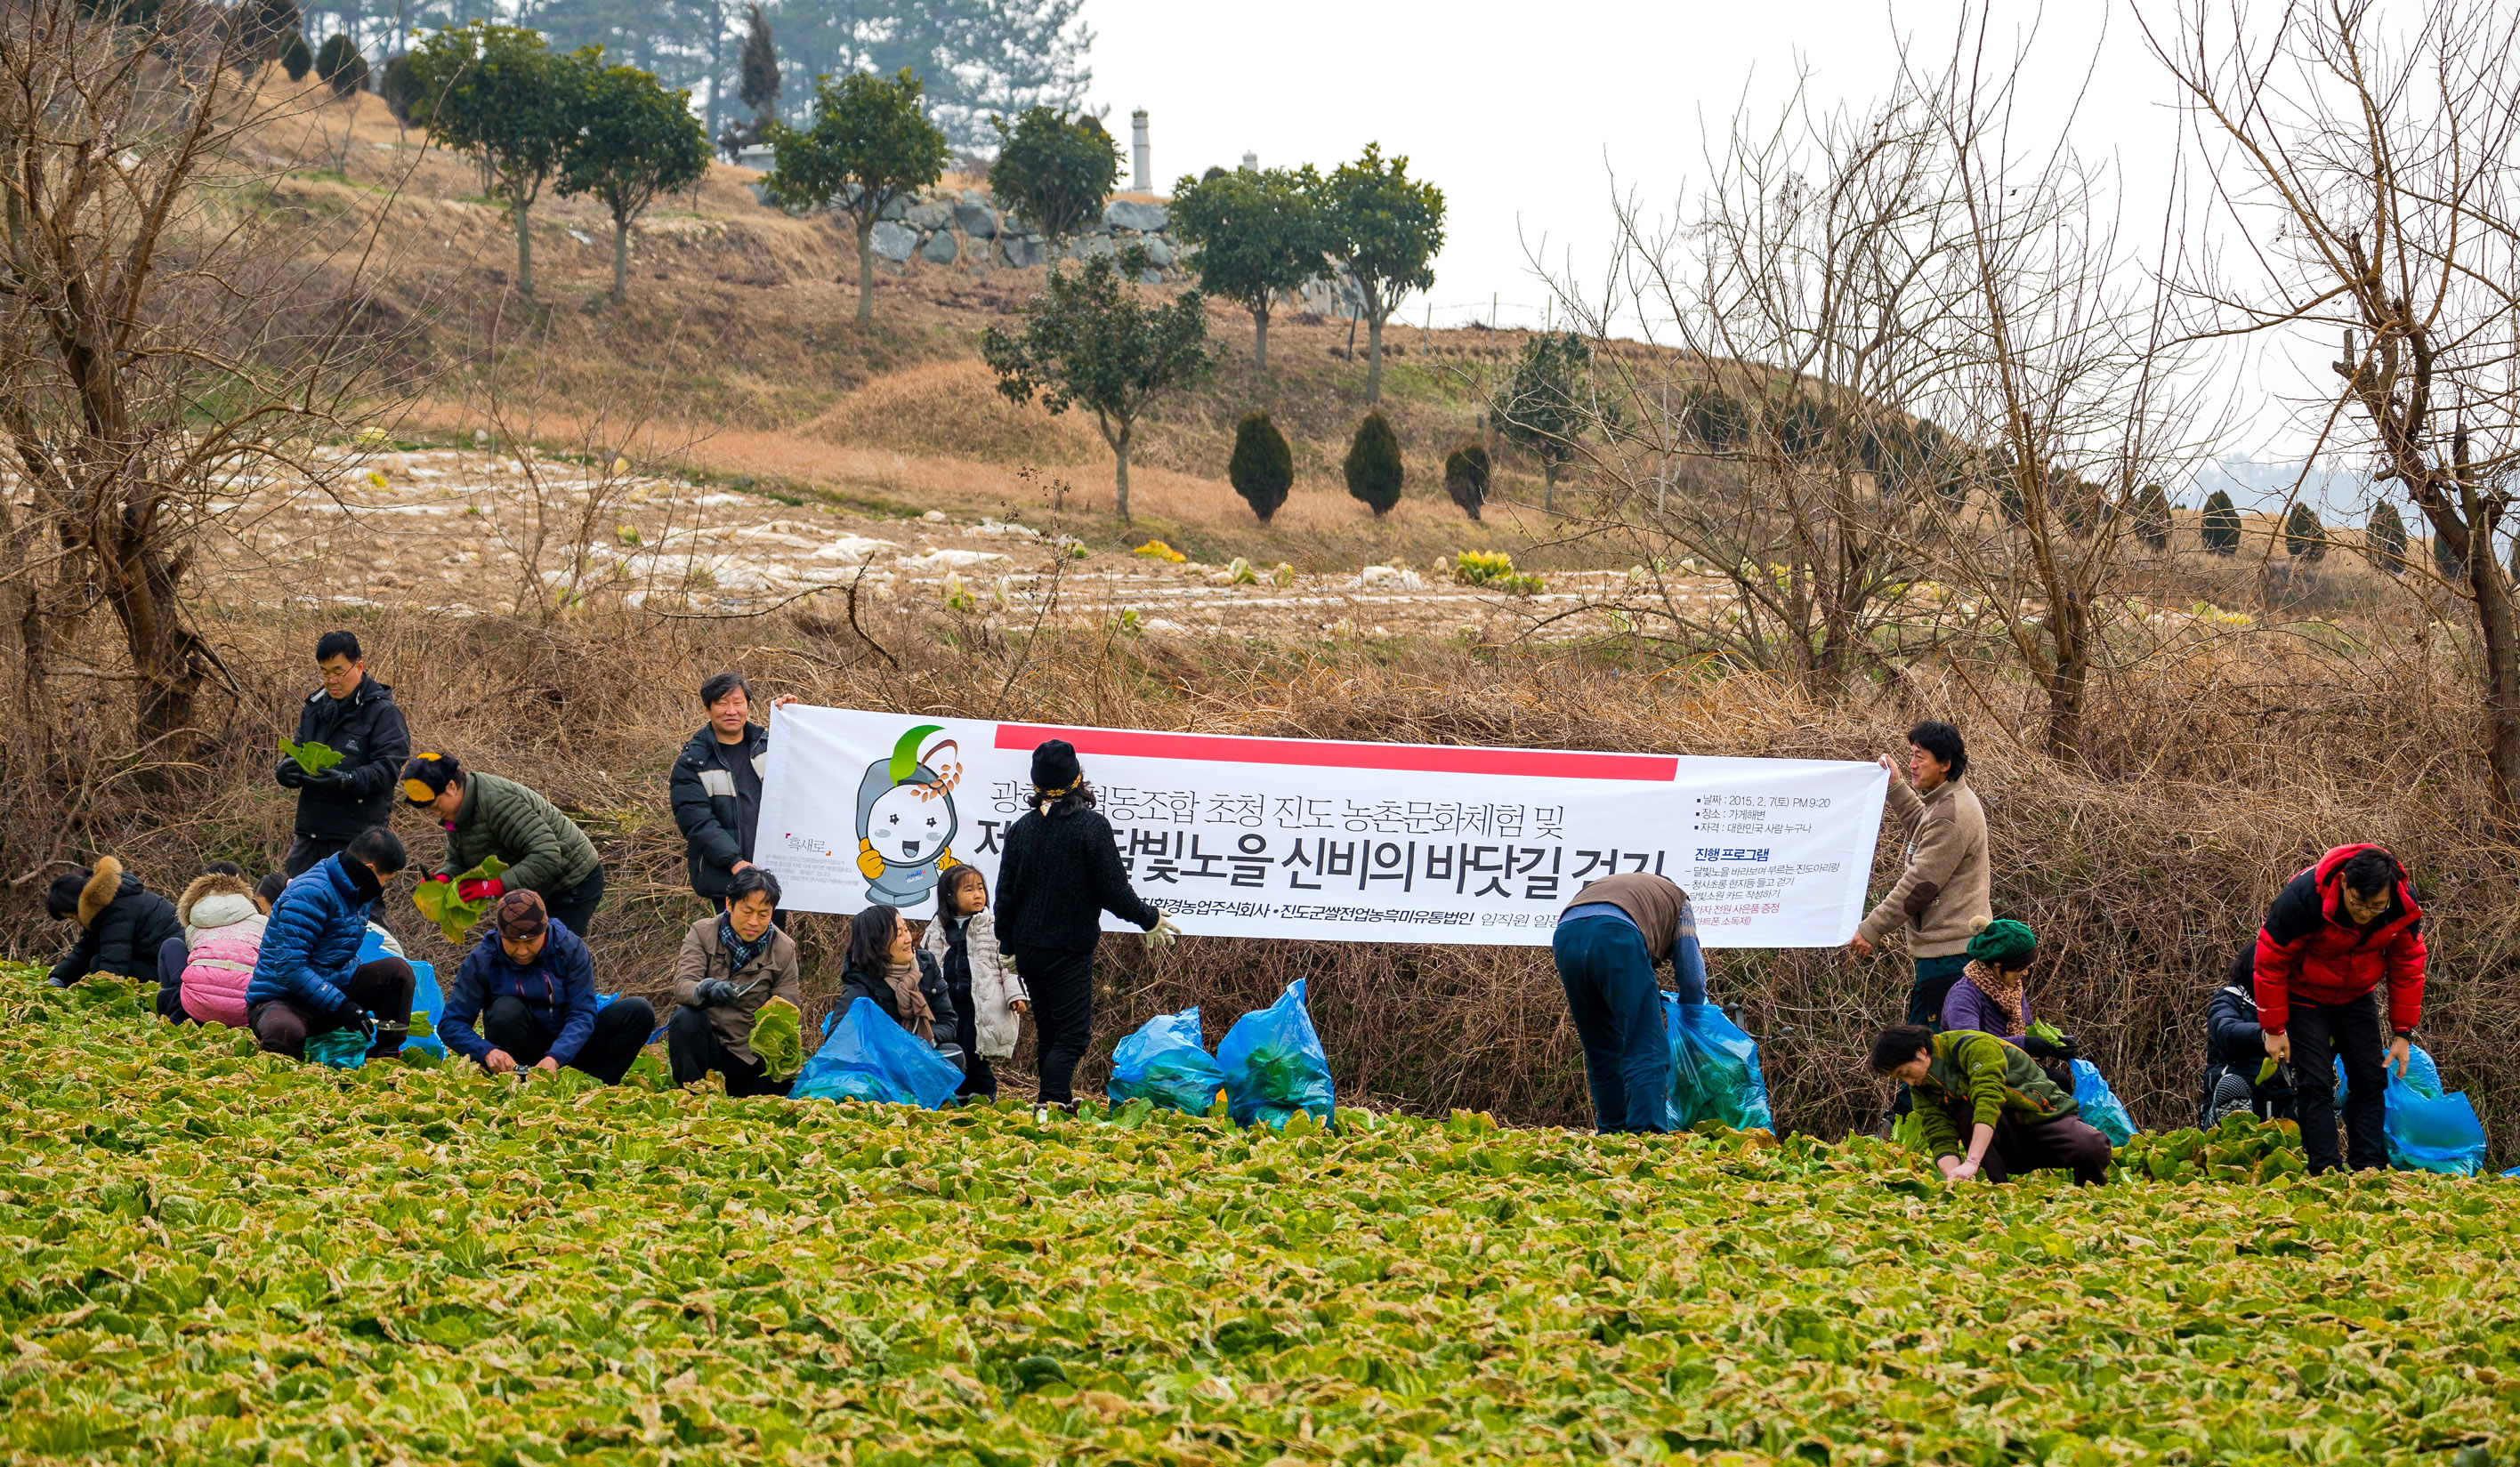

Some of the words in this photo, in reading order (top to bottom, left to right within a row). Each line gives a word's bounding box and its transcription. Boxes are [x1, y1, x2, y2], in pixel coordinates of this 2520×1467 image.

[1702, 794, 1722, 806] 날짜
[1204, 793, 1264, 827] 초청
[1272, 794, 1335, 829] 진도
[1341, 798, 1525, 838] 농촌문화체험
[1534, 804, 1563, 840] 및
[1701, 808, 1721, 819] 장소
[1728, 809, 1766, 821] 가게해변
[1700, 822, 1719, 834] 자격
[1727, 822, 1765, 834] 대한민국
[1766, 822, 1784, 834] 사람
[1784, 823, 1813, 834] 누구나
[1694, 847, 1720, 862] 진행
[1720, 848, 1770, 862] 프로그램
[1280, 837, 1416, 893] 신비의
[1426, 842, 1563, 900] 바닷길
[1693, 866, 1730, 878] 달빛노을
[1731, 866, 1766, 877] 바라보며
[1767, 864, 1795, 875] 부르는
[1796, 862, 1841, 875] 진도아리랑
[1692, 878, 1727, 891] 청사초롱
[1725, 891, 1744, 901] 카드
[1745, 889, 1781, 900] 작성하기
[1691, 905, 1713, 915] 가자
[1714, 904, 1732, 915] 전원
[1733, 903, 1759, 915] 사은품
[1760, 902, 1781, 914] 증정
[1482, 912, 1531, 928] 임직원
[1694, 917, 1720, 927] 마트폰
